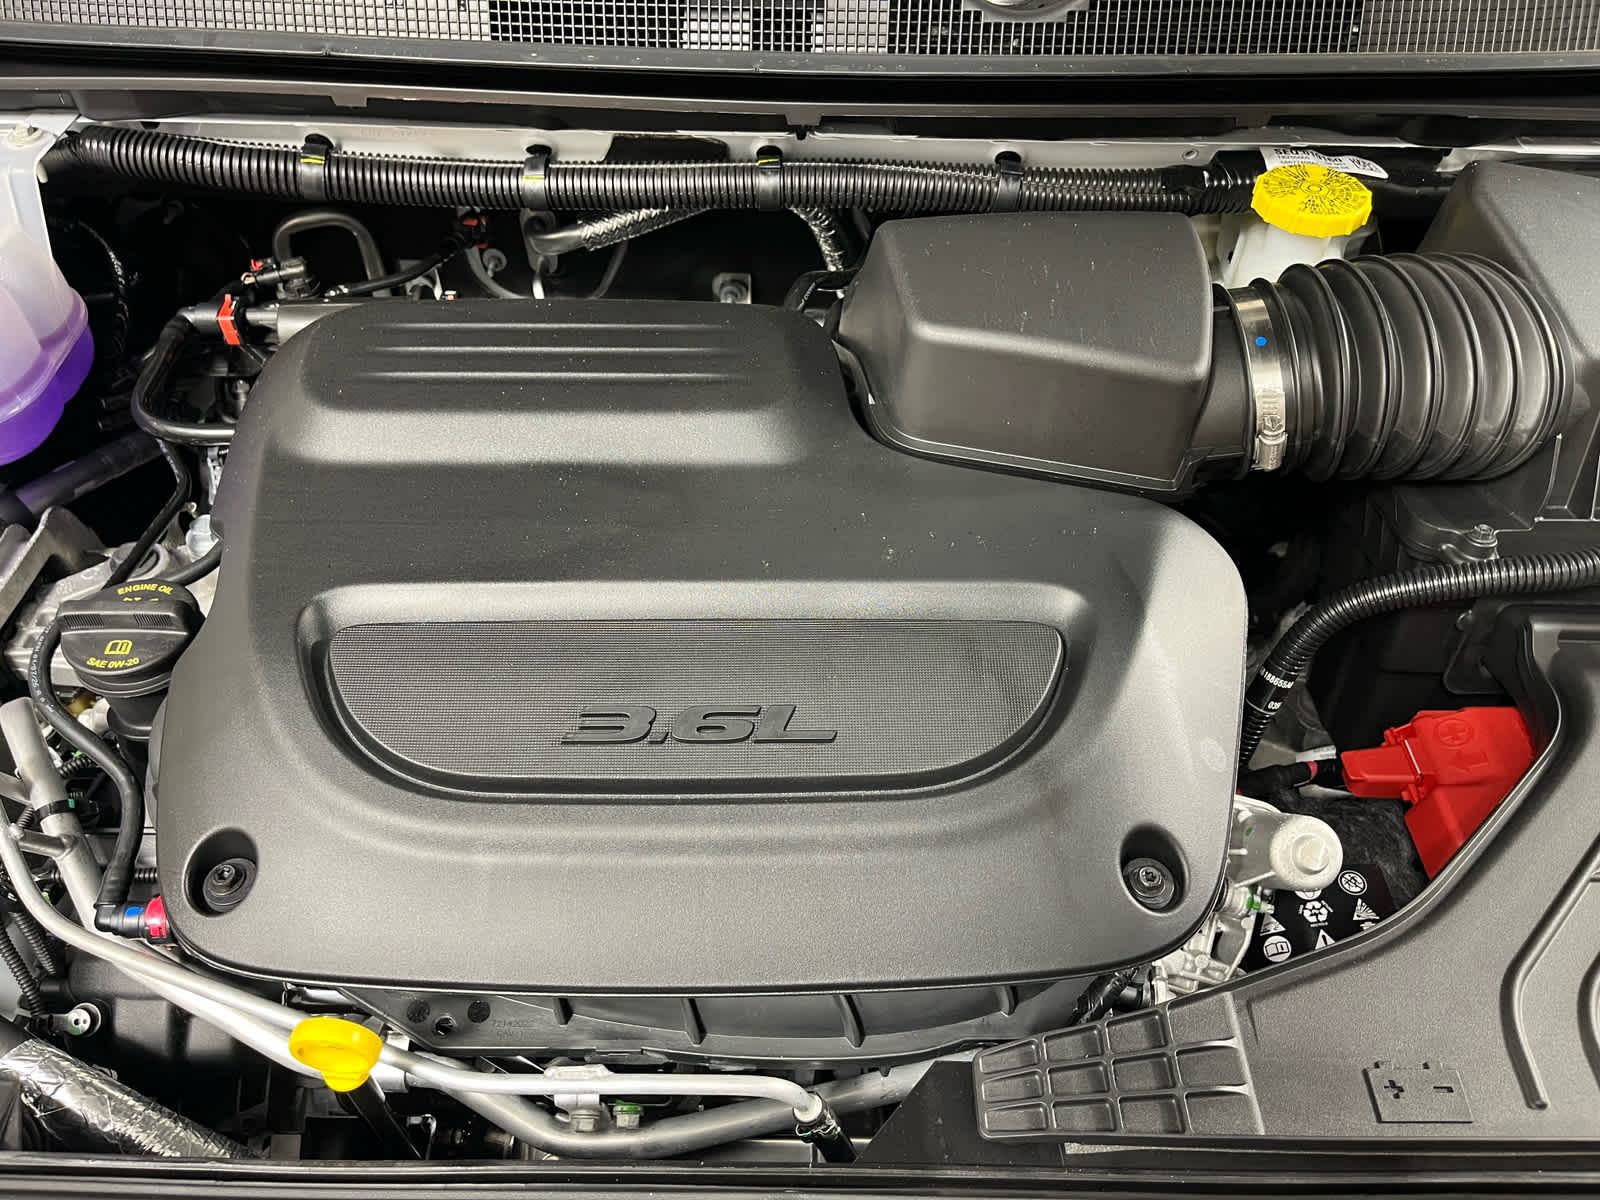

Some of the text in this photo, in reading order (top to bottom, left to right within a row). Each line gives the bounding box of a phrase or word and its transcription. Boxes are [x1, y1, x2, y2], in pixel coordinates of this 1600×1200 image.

[117, 584, 174, 595] ENGINE OIL
[87, 657, 140, 668] SAE 0W-20
[561, 705, 838, 744] 3.6L
